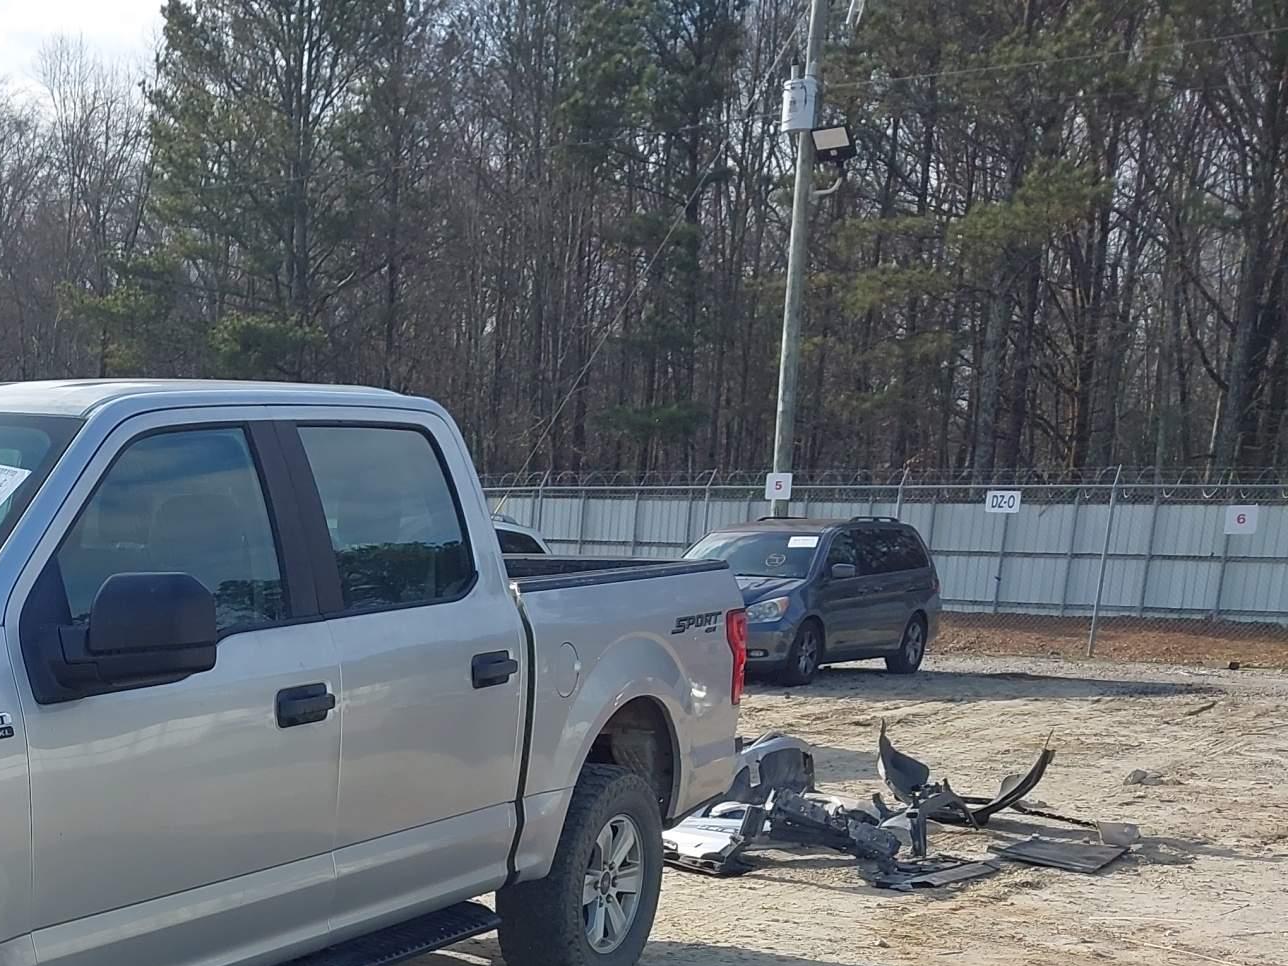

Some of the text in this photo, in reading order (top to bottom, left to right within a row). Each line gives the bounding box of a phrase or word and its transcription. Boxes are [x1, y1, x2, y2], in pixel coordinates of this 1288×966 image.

[775, 480, 783, 491] 5
[1236, 513, 1247, 525] 6
[671, 611, 722, 635] SPORT
